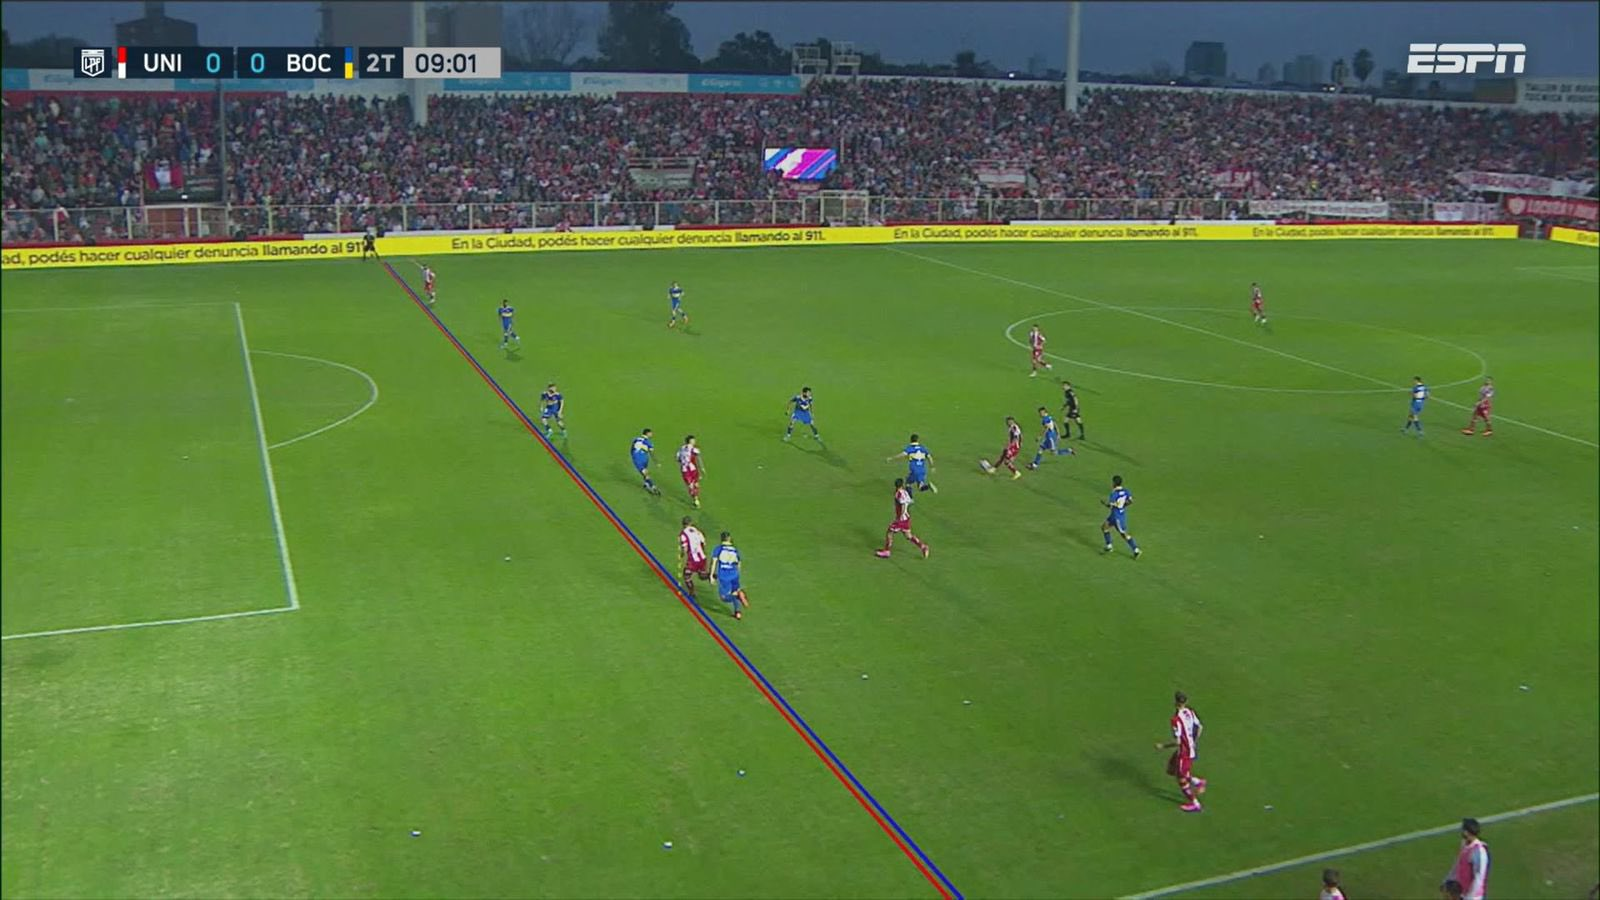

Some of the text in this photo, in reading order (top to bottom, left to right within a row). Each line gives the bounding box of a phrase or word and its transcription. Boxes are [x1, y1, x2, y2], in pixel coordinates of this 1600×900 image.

[452, 237, 469, 249] En
[472, 237, 483, 249] la
[486, 236, 535, 249] Ciudad,
[538, 234, 578, 247] podés
[580, 234, 614, 246] hacer
[617, 231, 673, 245] cualquier
[677, 231, 732, 244] denuncia
[735, 230, 789, 242] llamando
[792, 229, 802, 241] al
[894, 228, 909, 239] En
[1000, 227, 1028, 238] hacer
[29, 249, 76, 264] podés
[80, 249, 120, 262] hacer
[124, 247, 190, 262] cualquier
[194, 245, 258, 258] denuncia
[262, 243, 327, 256] llamando
[331, 243, 342, 254] al
